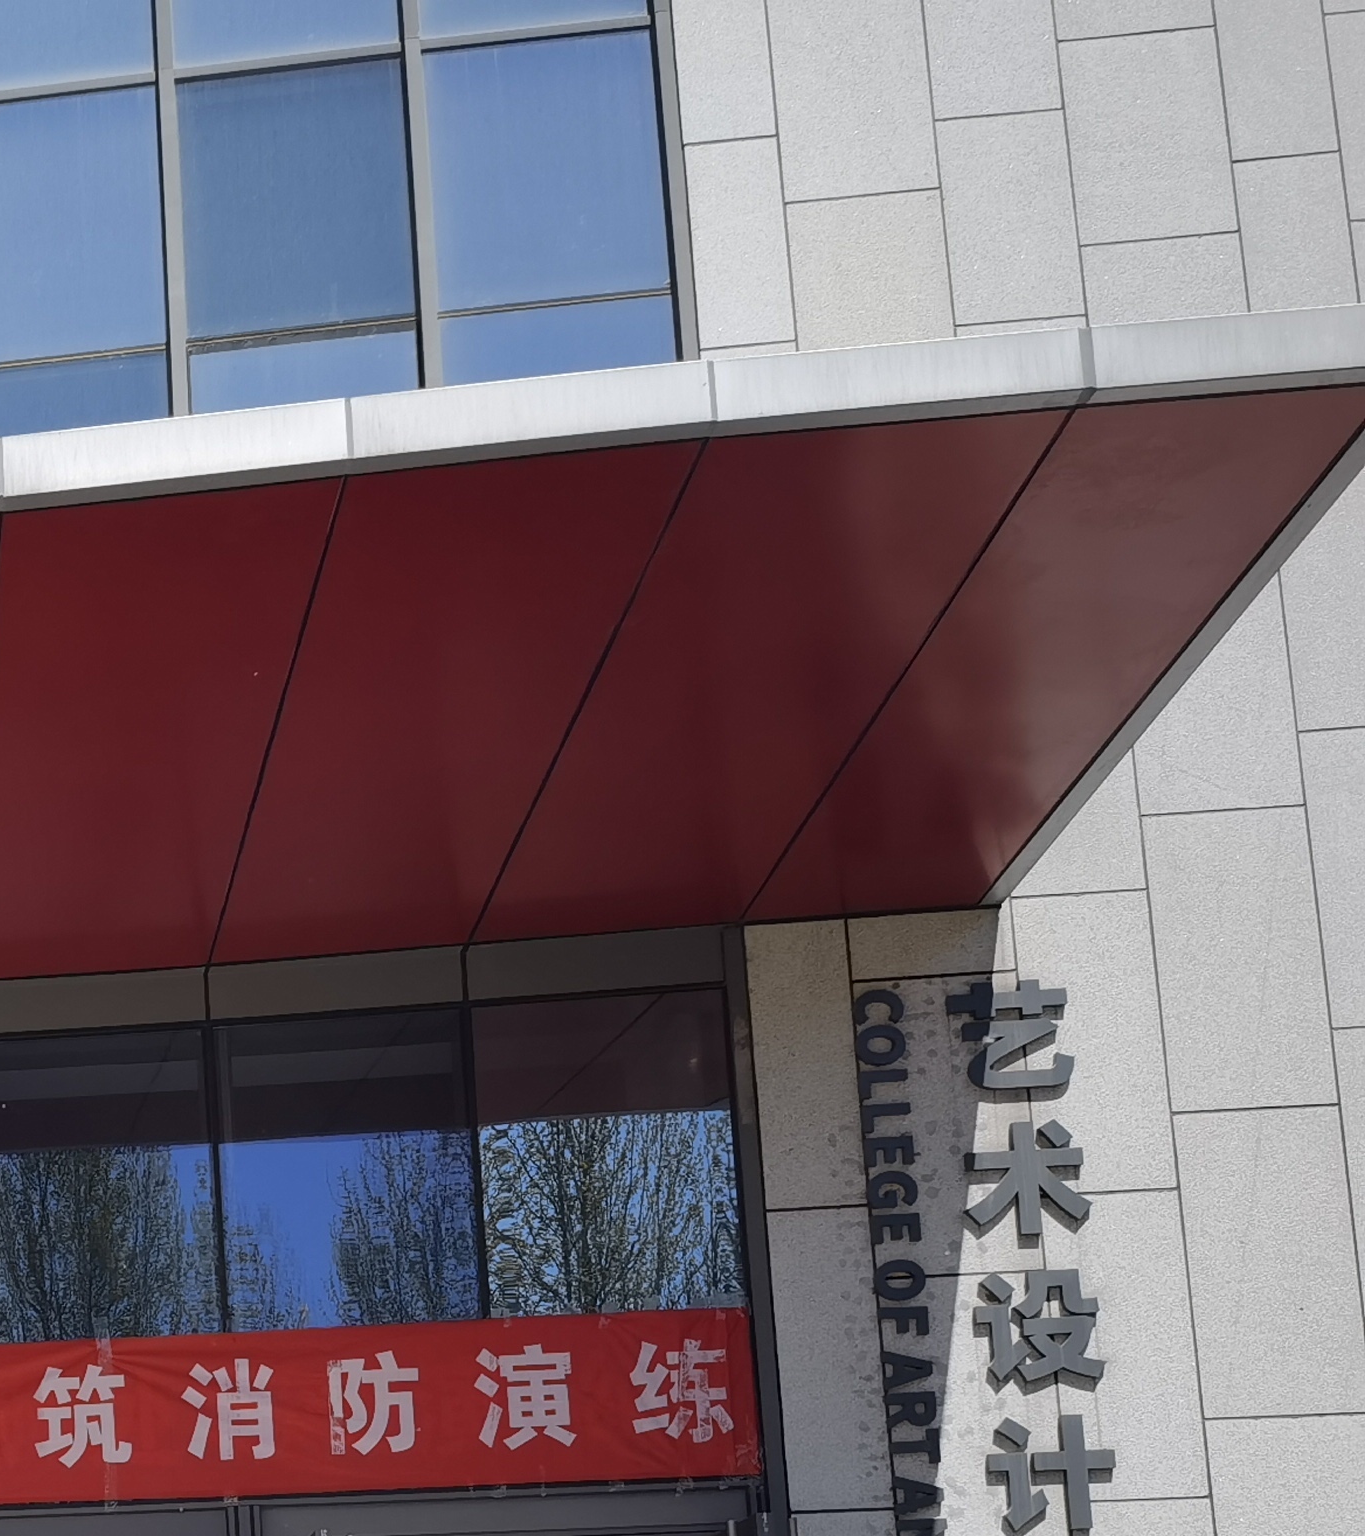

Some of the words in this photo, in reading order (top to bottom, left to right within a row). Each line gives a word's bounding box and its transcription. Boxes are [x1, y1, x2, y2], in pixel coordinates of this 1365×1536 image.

[852, 988, 923, 1249] COLLEGE
[873, 1258, 930, 1338] OF
[879, 1349, 942, 1464] ART
